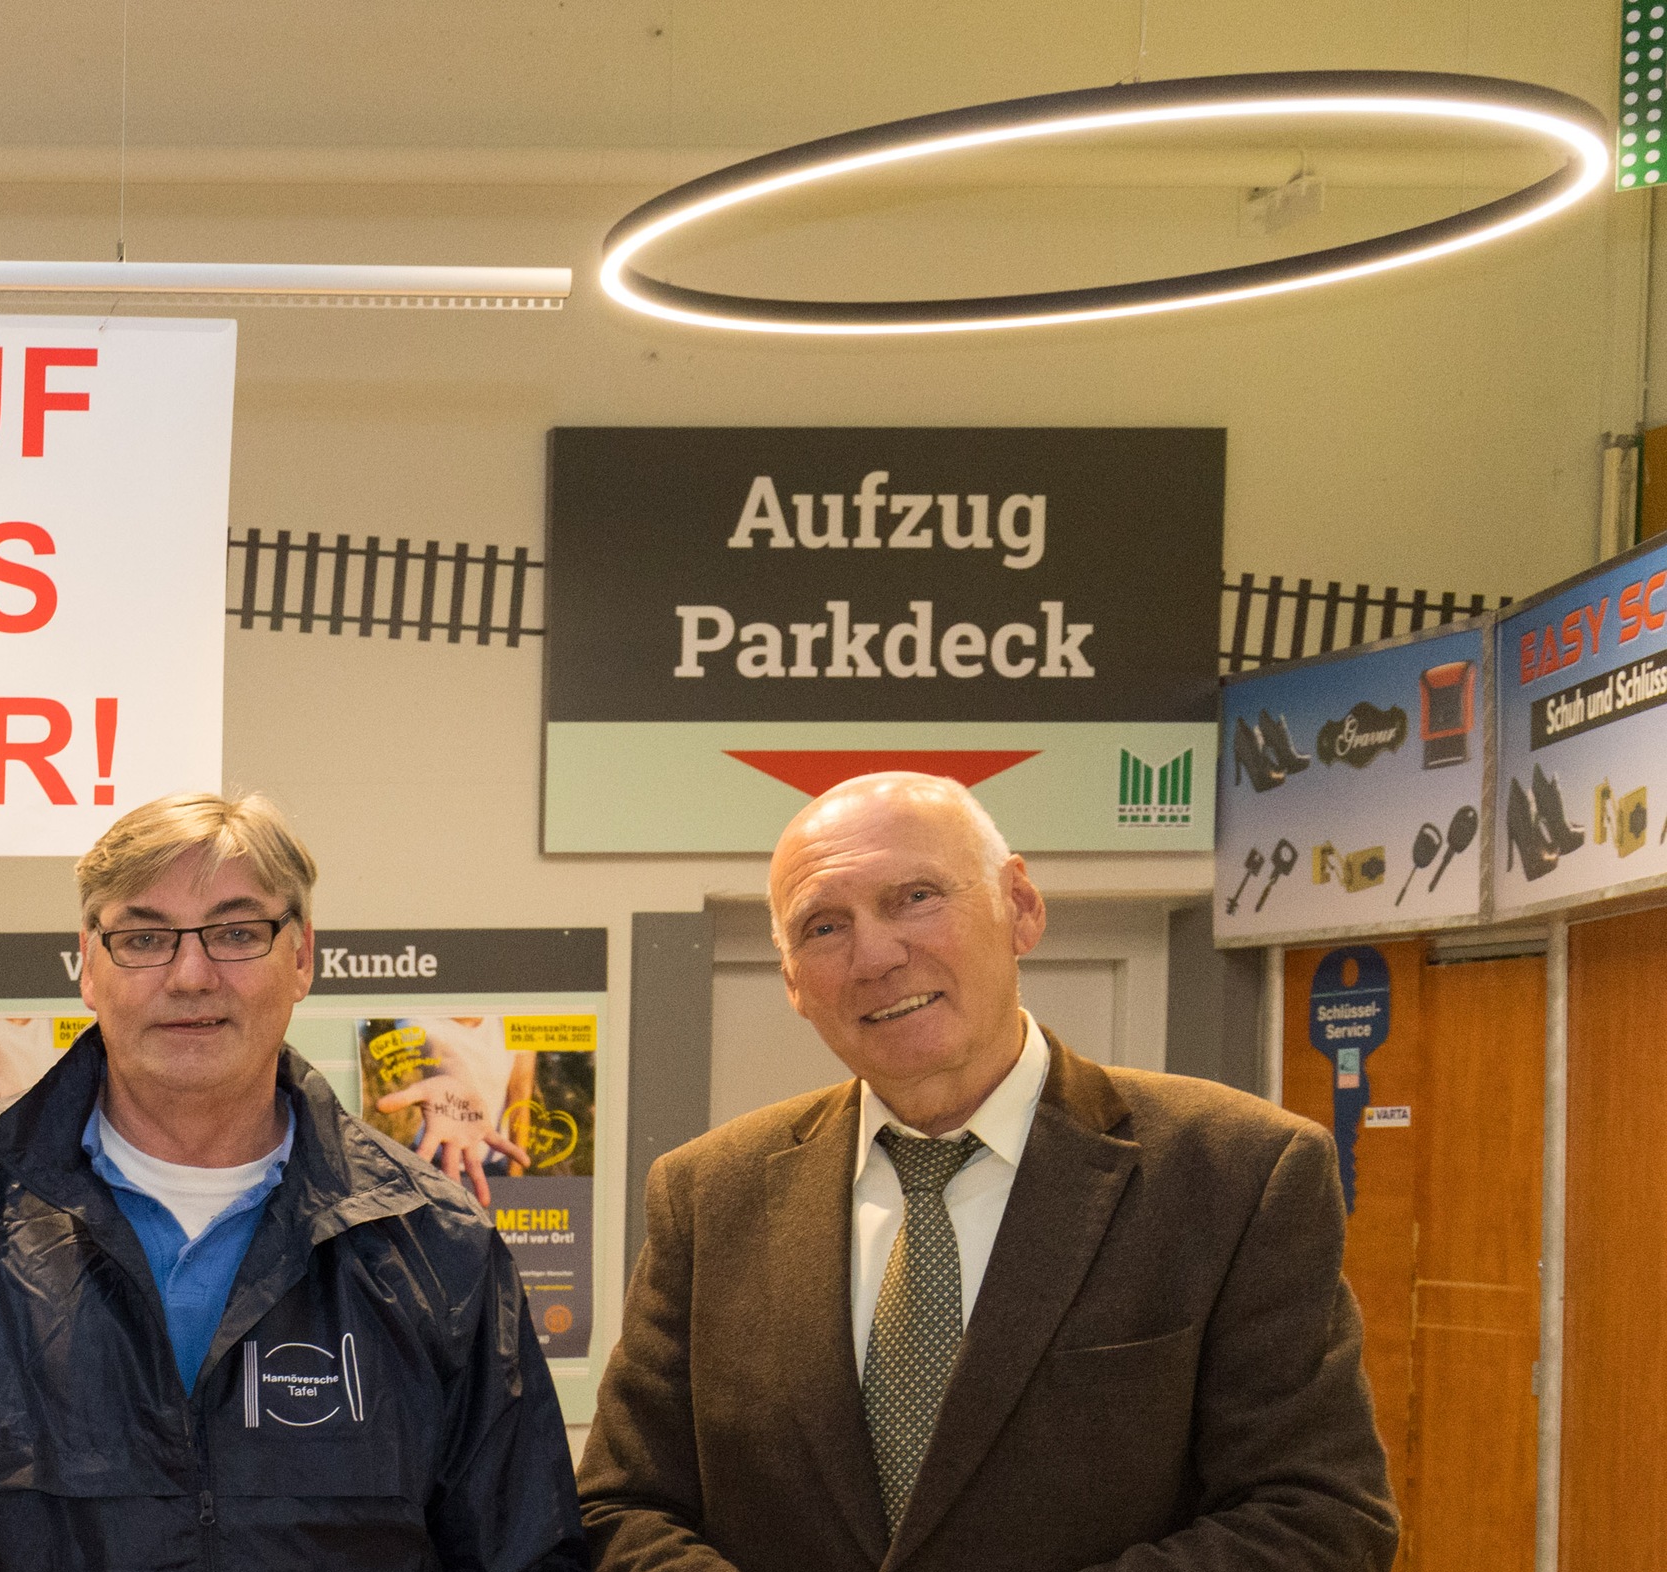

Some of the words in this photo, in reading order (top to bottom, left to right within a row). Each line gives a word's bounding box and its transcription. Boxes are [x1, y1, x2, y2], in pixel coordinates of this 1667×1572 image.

[728, 471, 1048, 569] Aufzug
[674, 601, 1095, 678] Parkdeck
[1520, 597, 1609, 685] EASY
[1546, 688, 1585, 735] Schuh
[1118, 806, 1191, 814] MARKTKAUF
[320, 945, 438, 981] Kunde
[1317, 1001, 1381, 1021] Schlüssel-
[511, 1025, 591, 1033] Aktionszeitraum
[1325, 1022, 1372, 1039] Service
[1376, 1109, 1409, 1119] VARTA
[496, 1209, 569, 1230] MEHR!
[551, 1233, 574, 1244] Ort!
[263, 1374, 339, 1384] Hannöversche
[288, 1386, 317, 1396] Tafel
